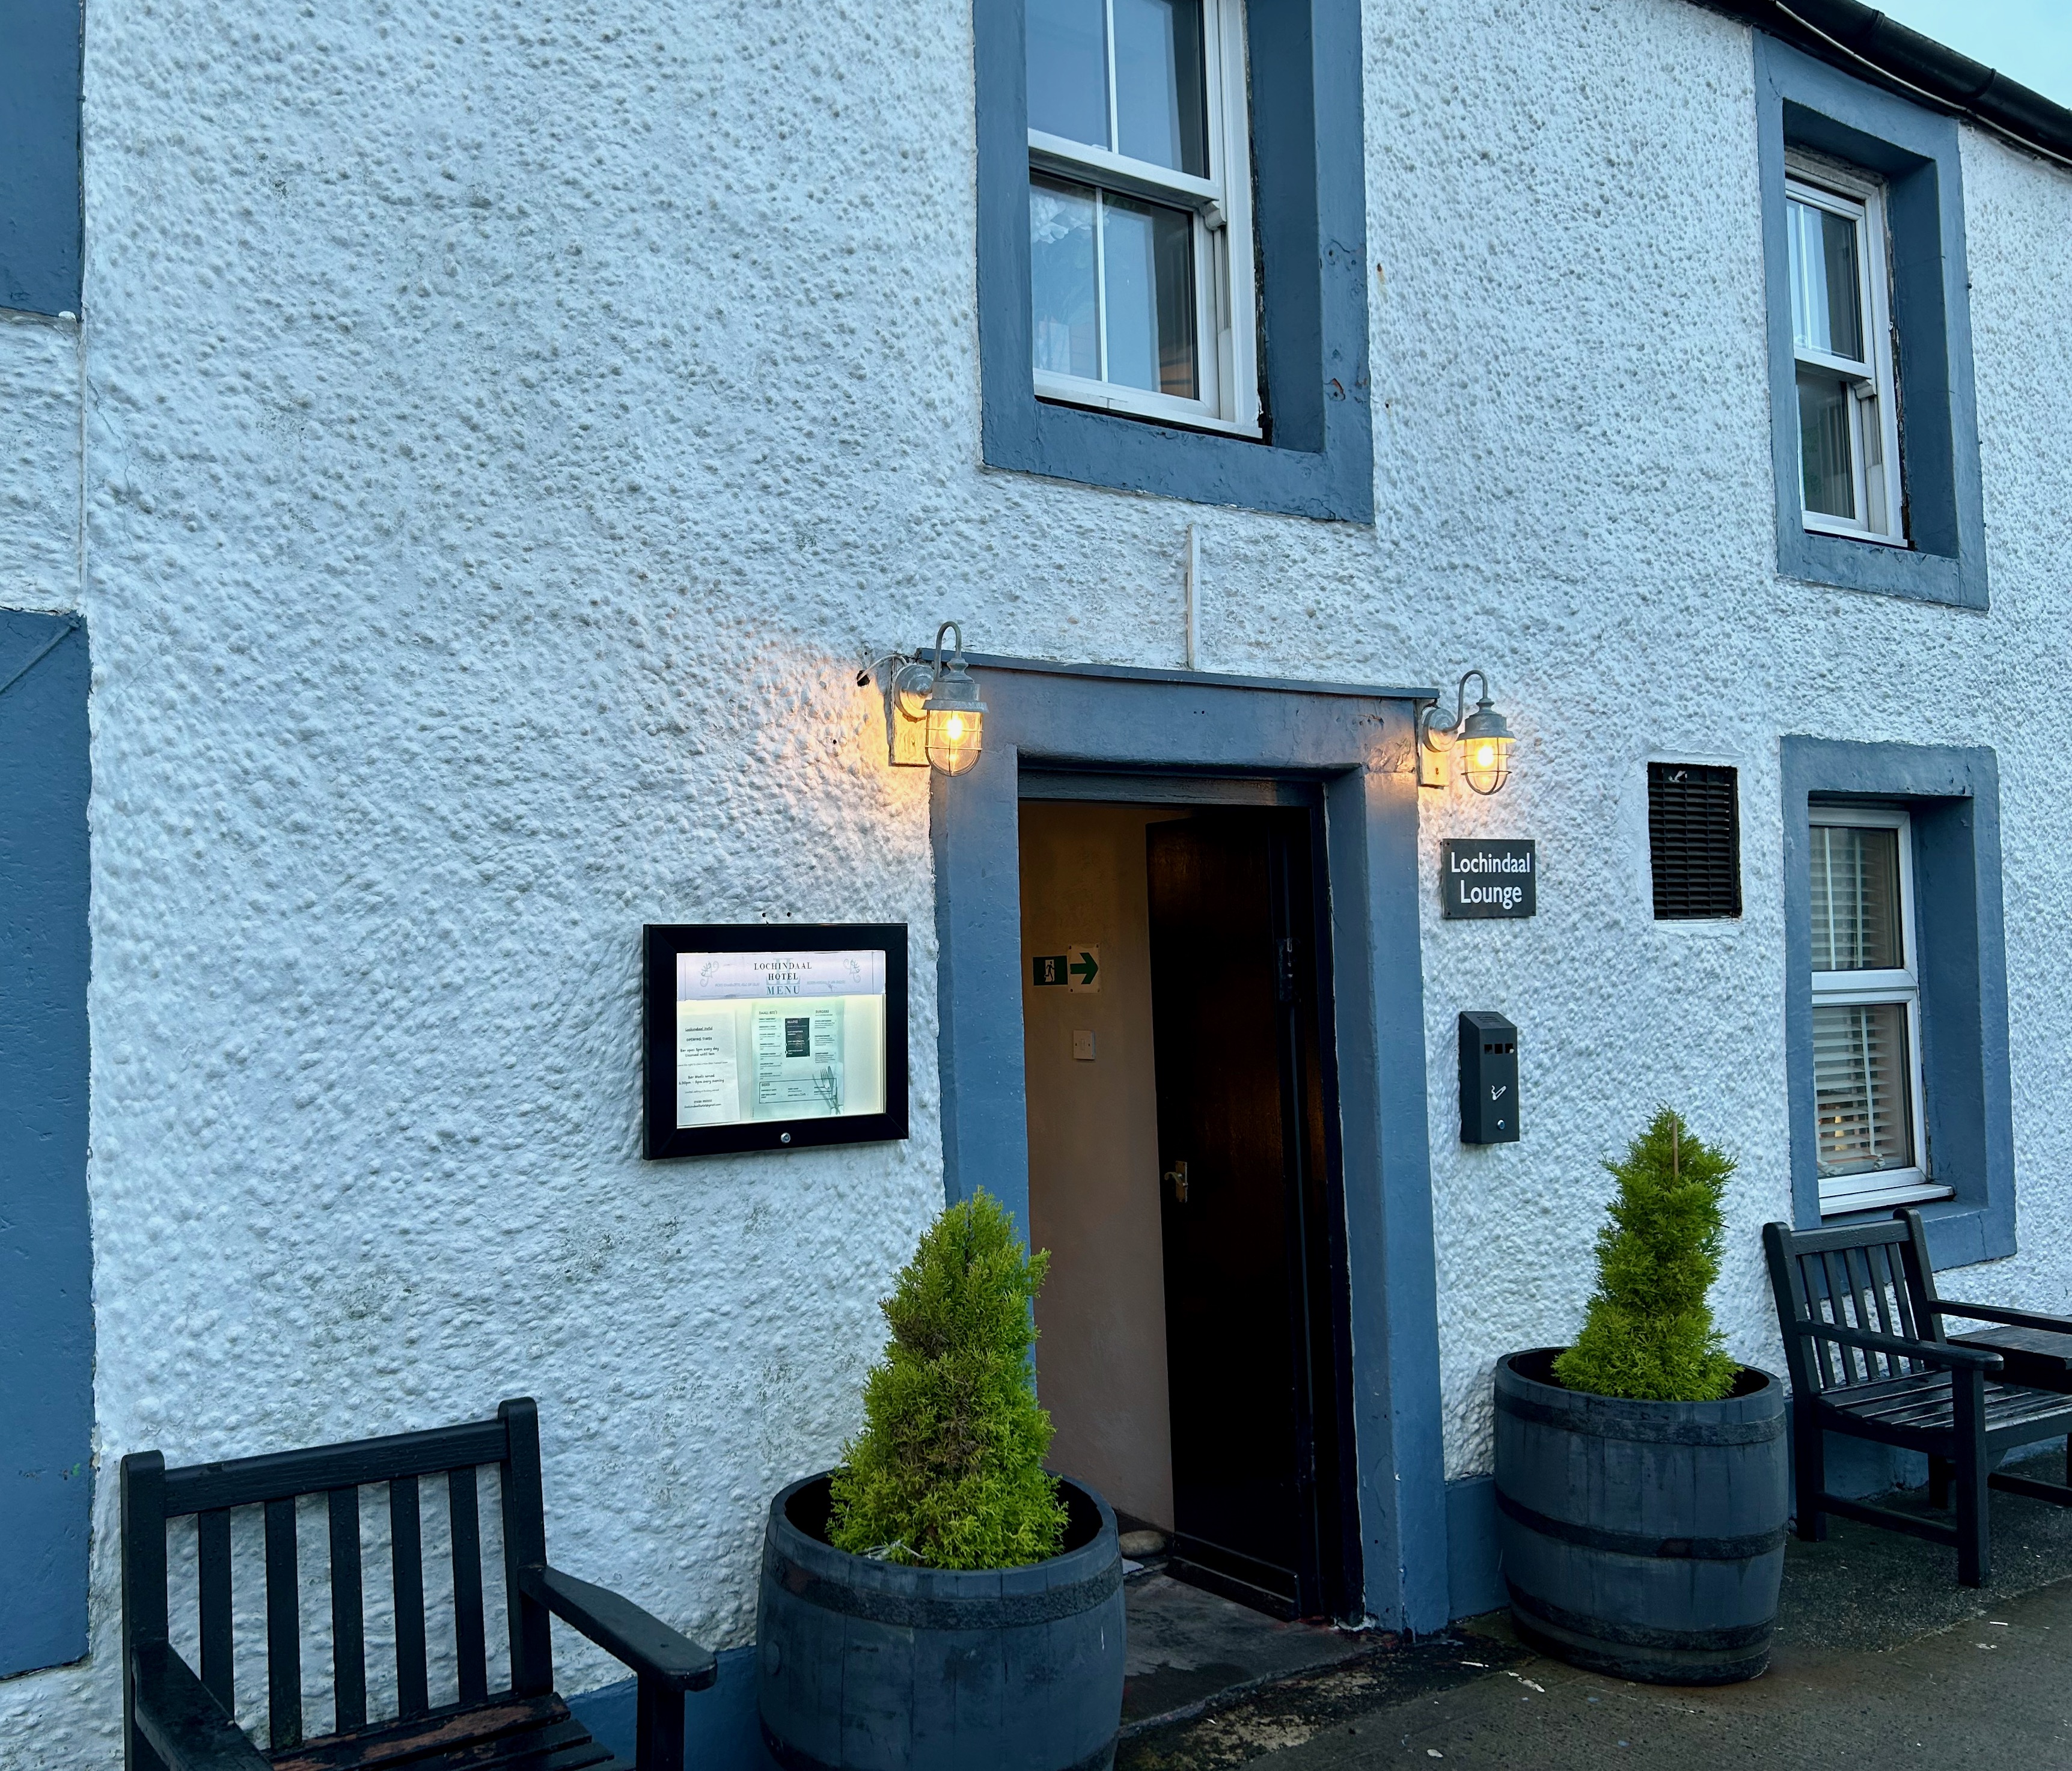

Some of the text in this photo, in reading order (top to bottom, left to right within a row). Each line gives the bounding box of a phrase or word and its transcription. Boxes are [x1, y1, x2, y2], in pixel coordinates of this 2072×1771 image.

[1451, 852, 1530, 873] Lochindaal
[1460, 879, 1522, 910] Lounge
[754, 962, 812, 971] LOCHINDAAL
[766, 986, 800, 995] MENU
